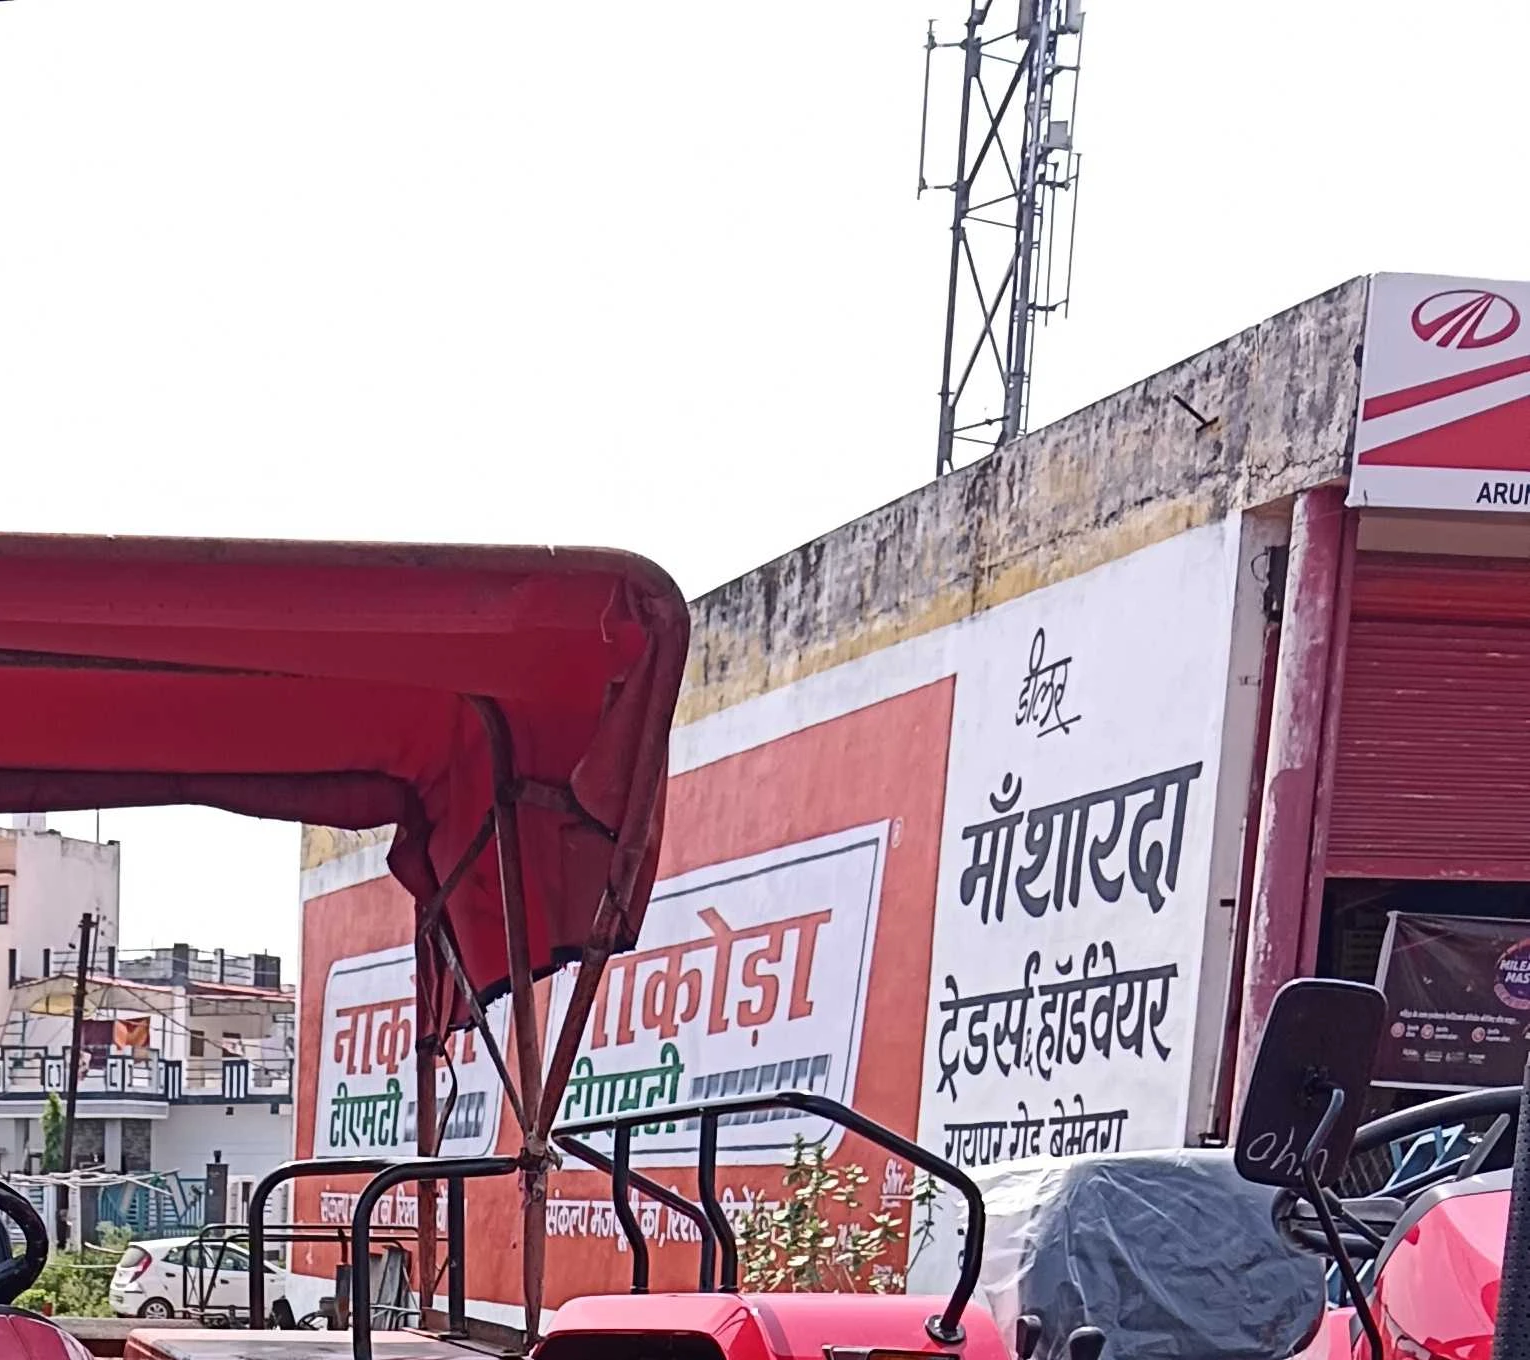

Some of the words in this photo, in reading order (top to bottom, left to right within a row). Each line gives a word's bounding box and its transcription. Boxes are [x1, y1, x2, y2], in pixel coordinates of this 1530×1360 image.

[1500, 959, 1530, 972] MILE
[936, 950, 1041, 1103] ट्रेडर्स
[330, 1078, 403, 1147] टीएमटी
